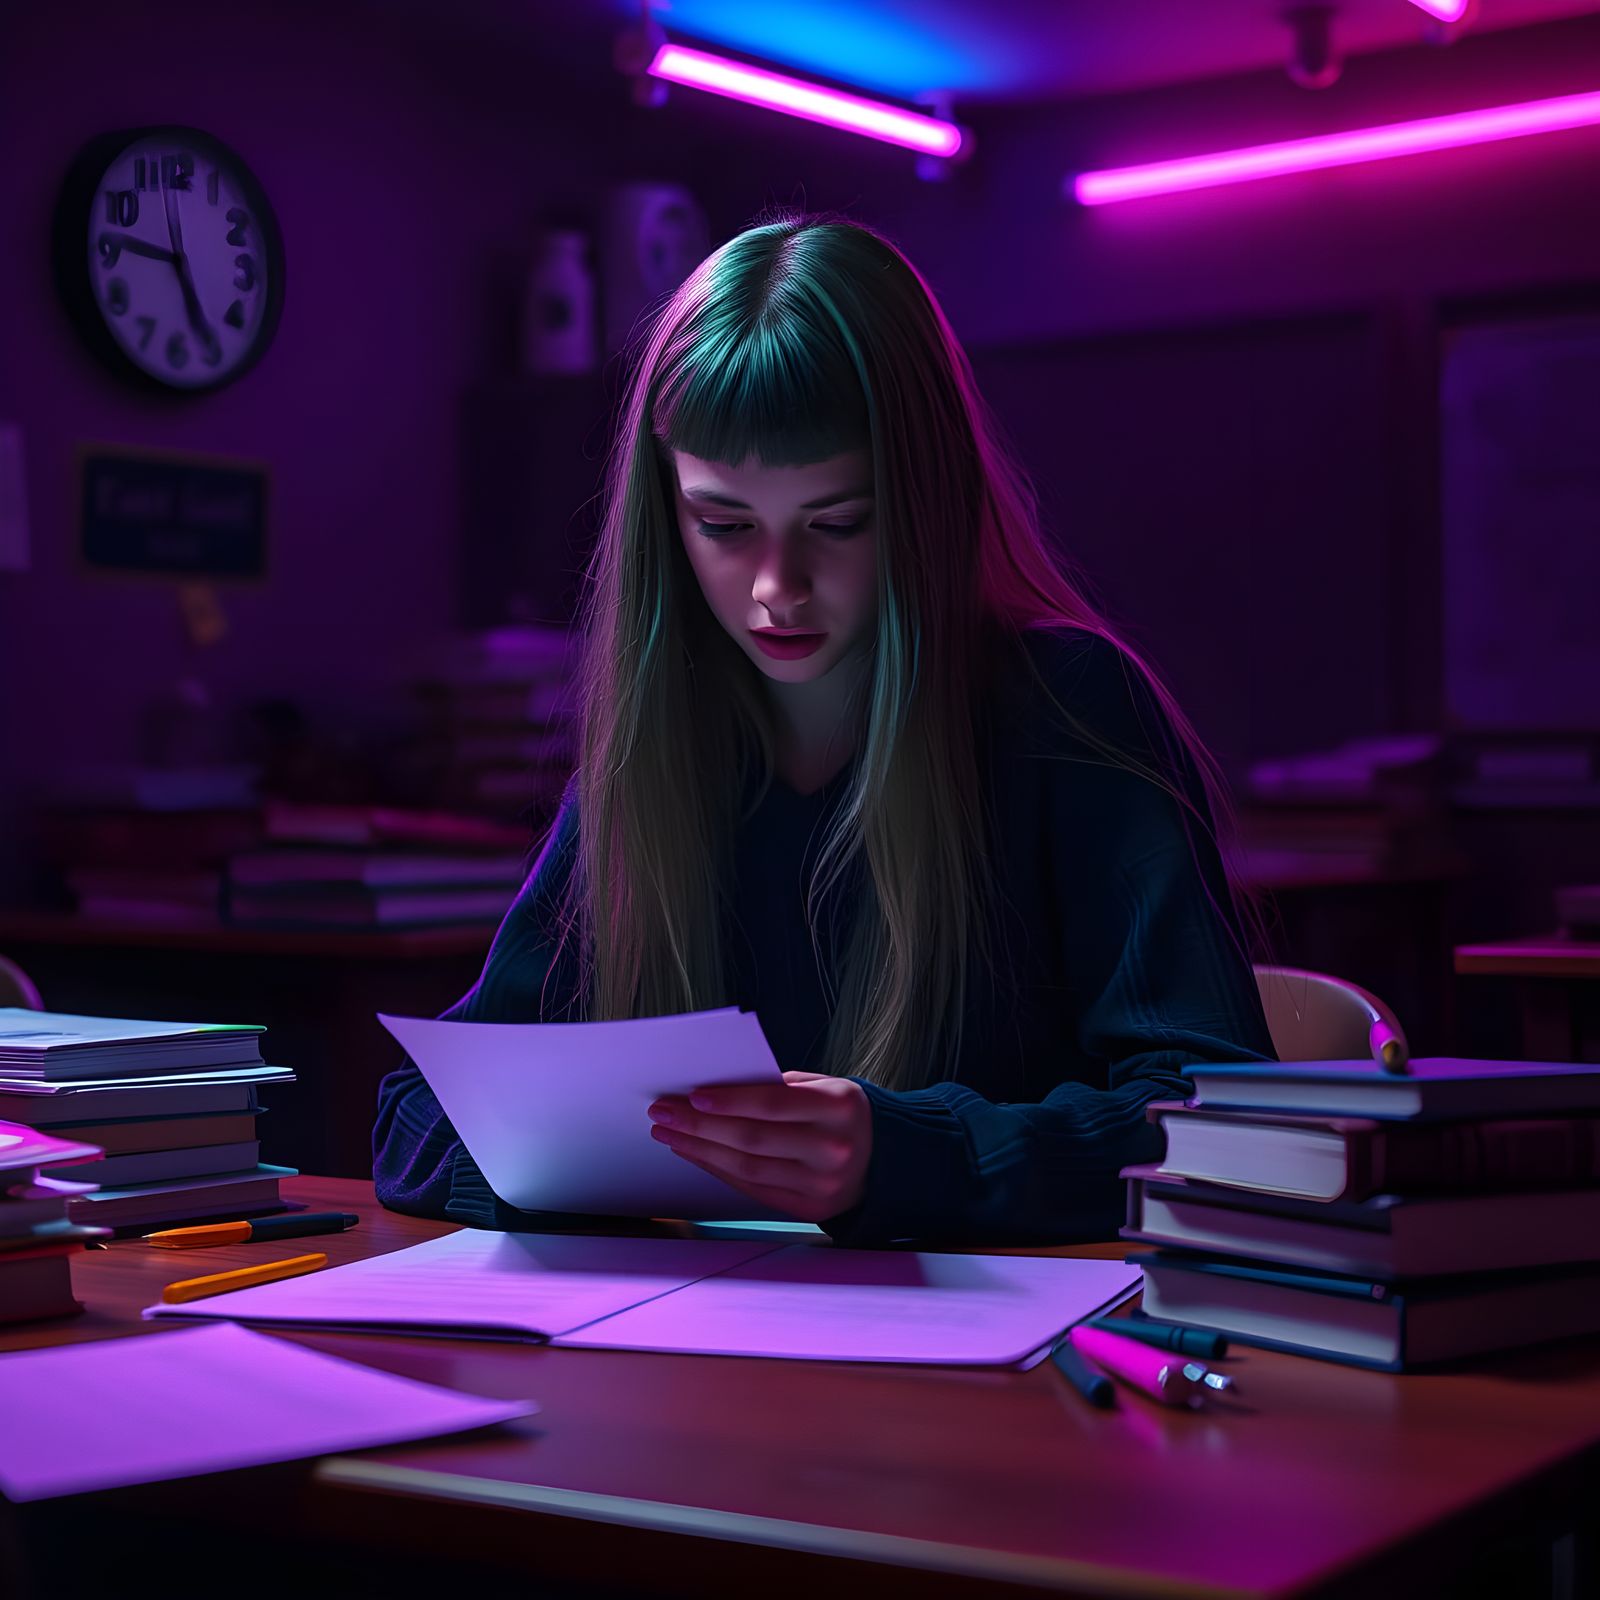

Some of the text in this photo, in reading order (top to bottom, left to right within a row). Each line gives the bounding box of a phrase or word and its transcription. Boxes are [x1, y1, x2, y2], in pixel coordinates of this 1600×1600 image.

[207, 171, 219, 206] 1
[106, 189, 139, 227] 10
[226, 207, 248, 246] 2
[99, 233, 121, 269] 9
[233, 253, 254, 292] 3
[136, 316, 157, 350] 7
